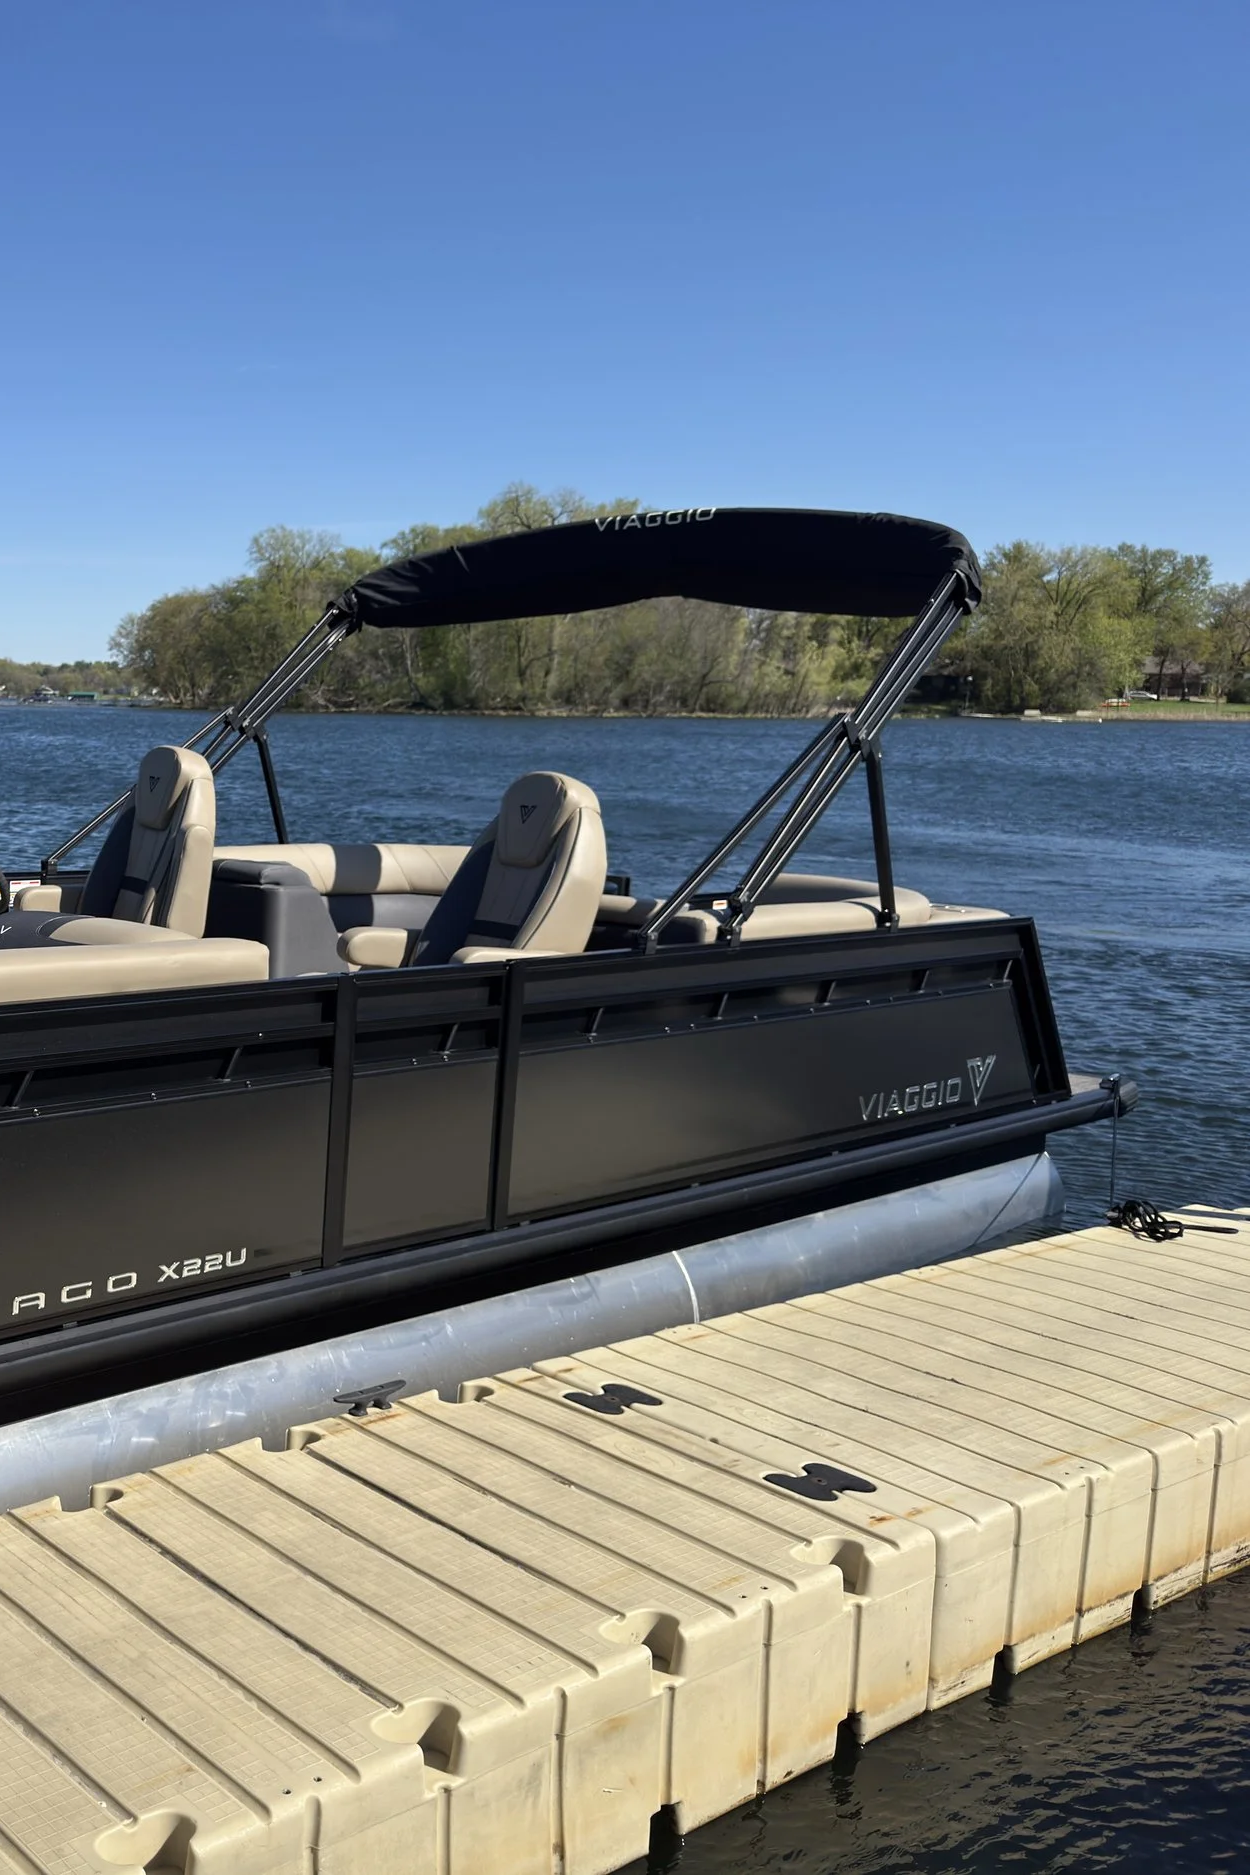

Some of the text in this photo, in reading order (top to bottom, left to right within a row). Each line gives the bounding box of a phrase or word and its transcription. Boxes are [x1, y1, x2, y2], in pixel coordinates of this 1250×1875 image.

[595, 507, 717, 532] VIAGGIO
[859, 1077, 962, 1121] VIAGGIO
[157, 1247, 247, 1283] X22U
